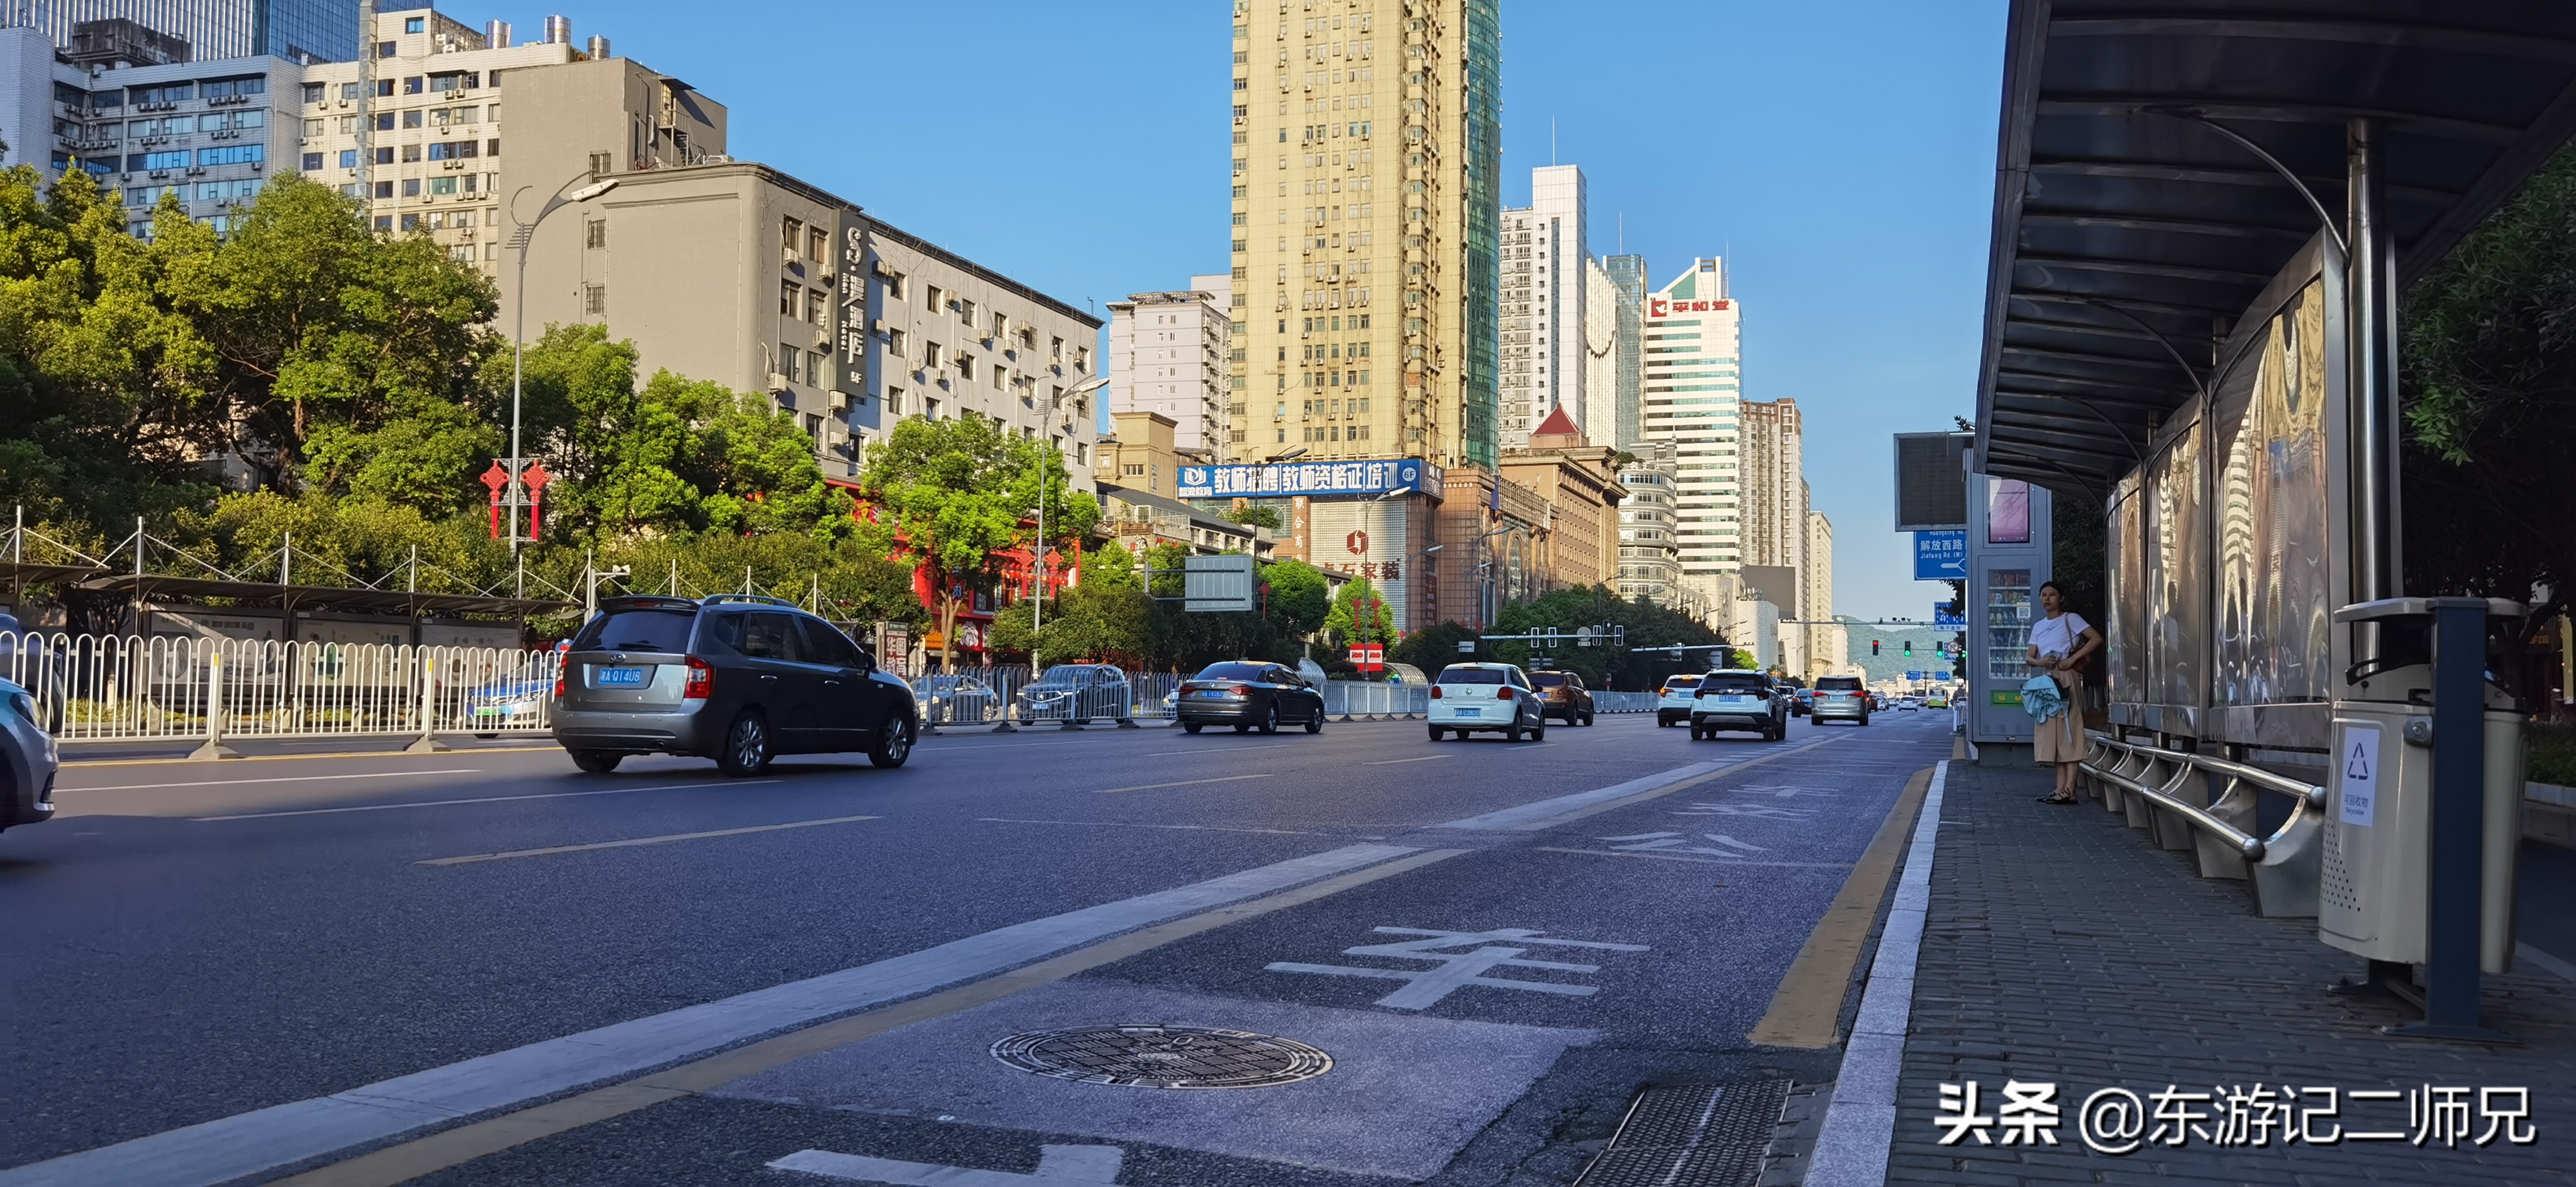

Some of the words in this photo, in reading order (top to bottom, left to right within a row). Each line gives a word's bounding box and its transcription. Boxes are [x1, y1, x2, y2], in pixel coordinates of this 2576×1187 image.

[1214, 466, 1279, 494] 教师招聘
[1282, 463, 1363, 492] 教师资格证
[1367, 462, 1398, 489] 培训
[1404, 470, 1415, 478] 6F
[1294, 497, 1305, 561] 联合商
[1920, 539, 1963, 551] 解放西路
[2345, 794, 2368, 808] 可回收物
